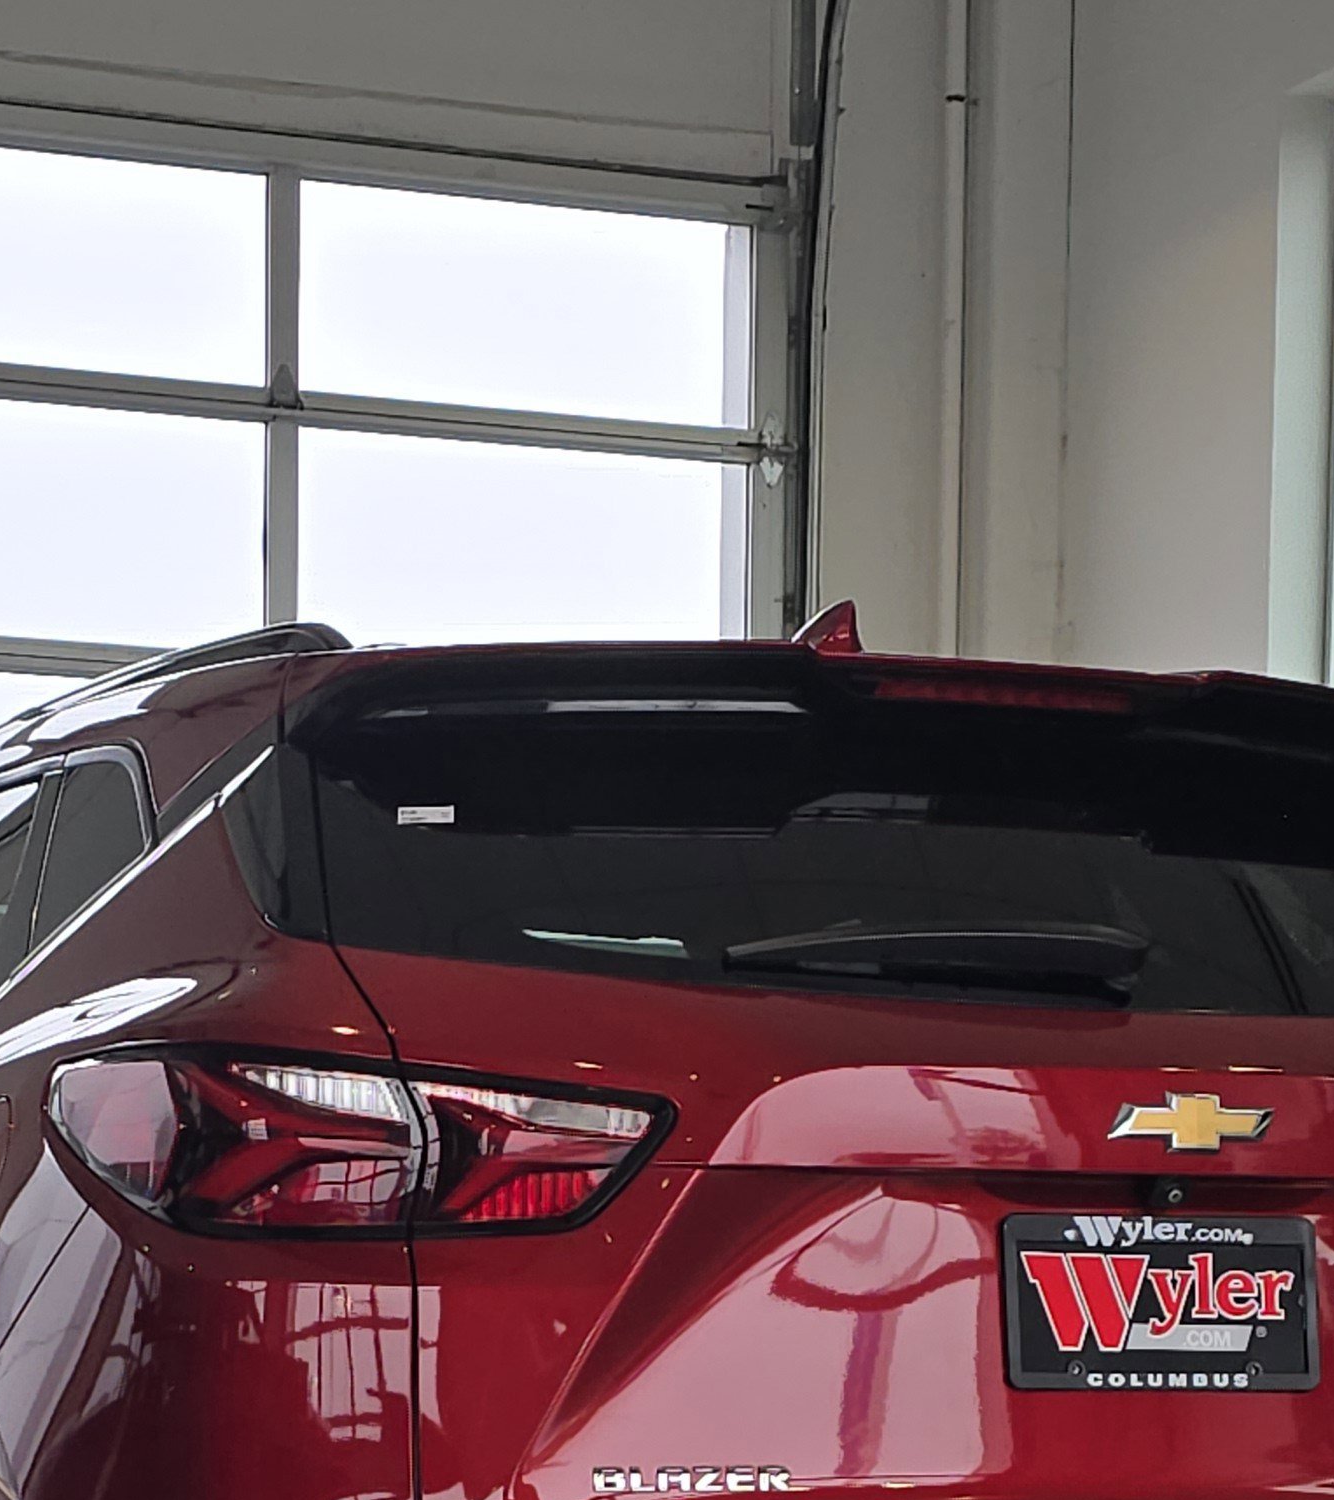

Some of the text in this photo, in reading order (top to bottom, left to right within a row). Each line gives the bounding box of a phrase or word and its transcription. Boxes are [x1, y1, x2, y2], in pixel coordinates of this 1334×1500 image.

[1020, 1251, 1295, 1352] Wyler
[1086, 1372, 1250, 1388] COLUMBUS
[592, 1465, 790, 1492] BLAZER
